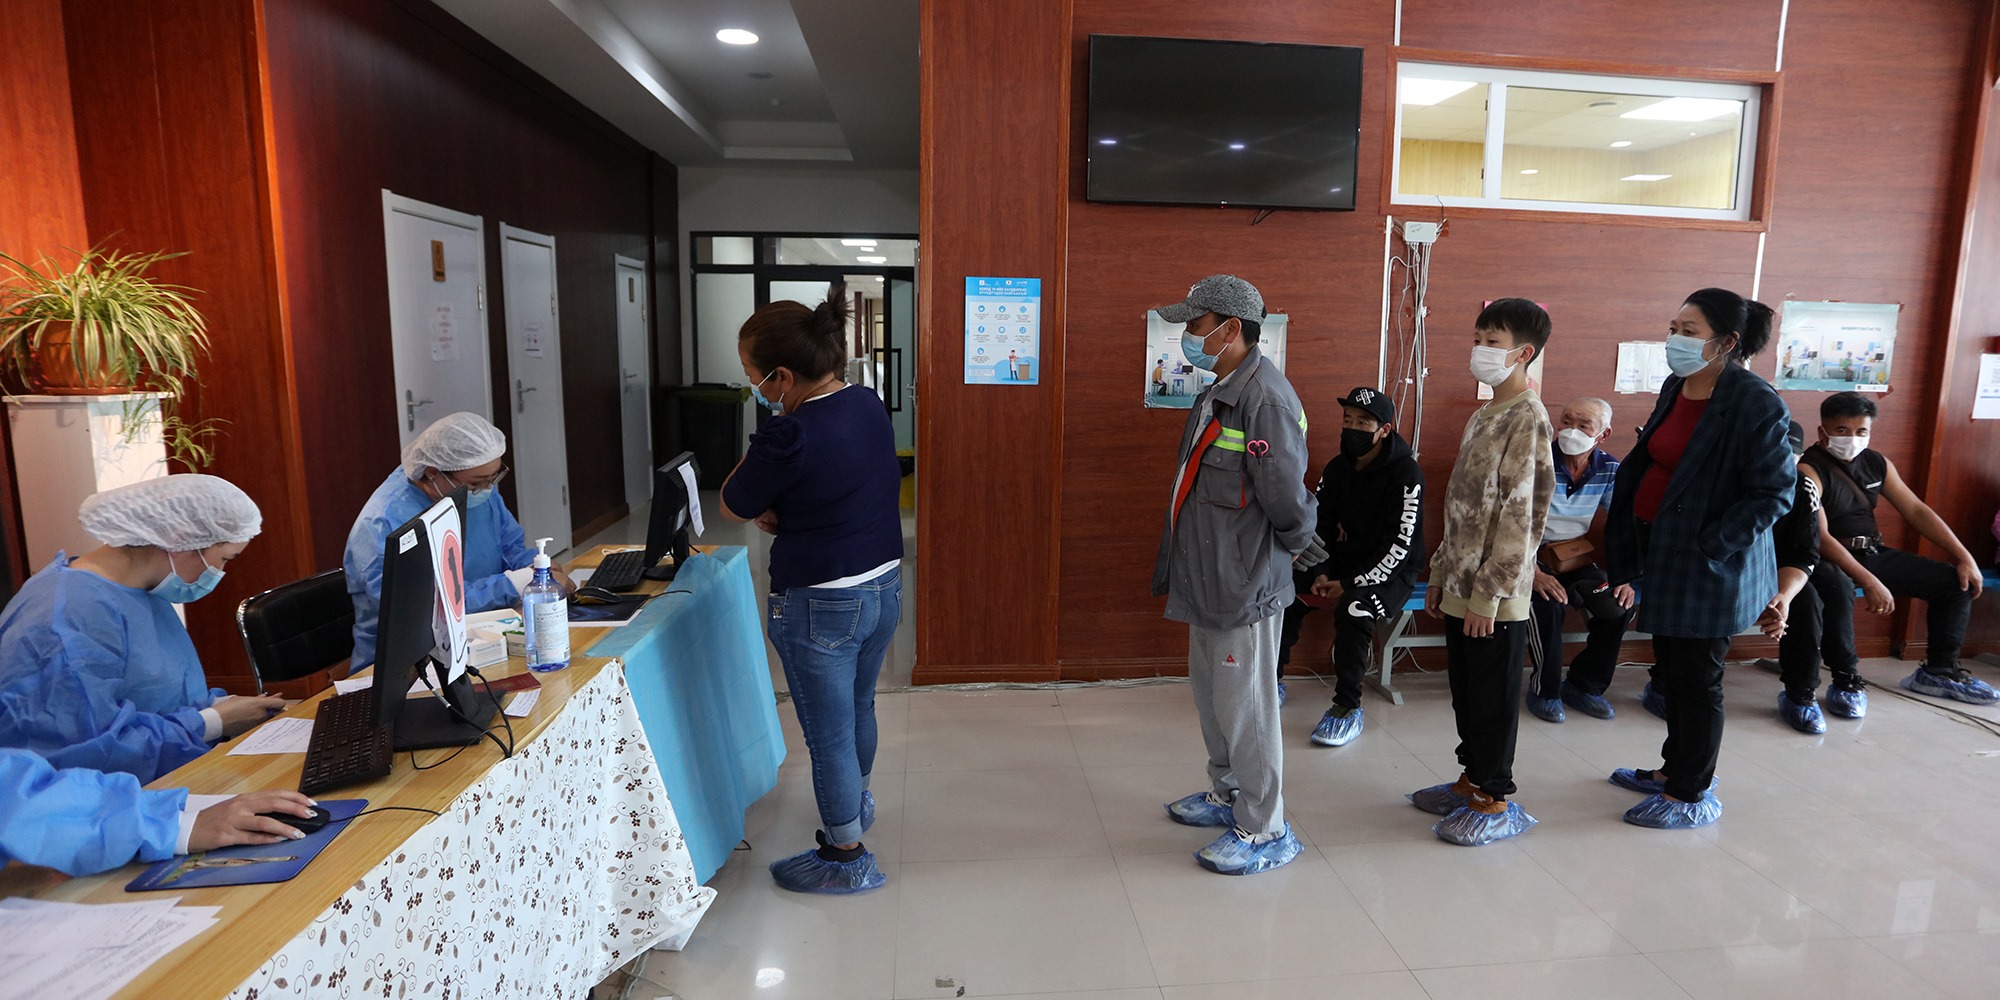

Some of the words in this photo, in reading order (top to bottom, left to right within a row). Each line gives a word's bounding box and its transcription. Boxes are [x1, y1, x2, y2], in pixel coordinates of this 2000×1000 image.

[1397, 484, 1421, 546] Super
[448, 547, 461, 605] 1
[1370, 594, 1386, 620] NIK
